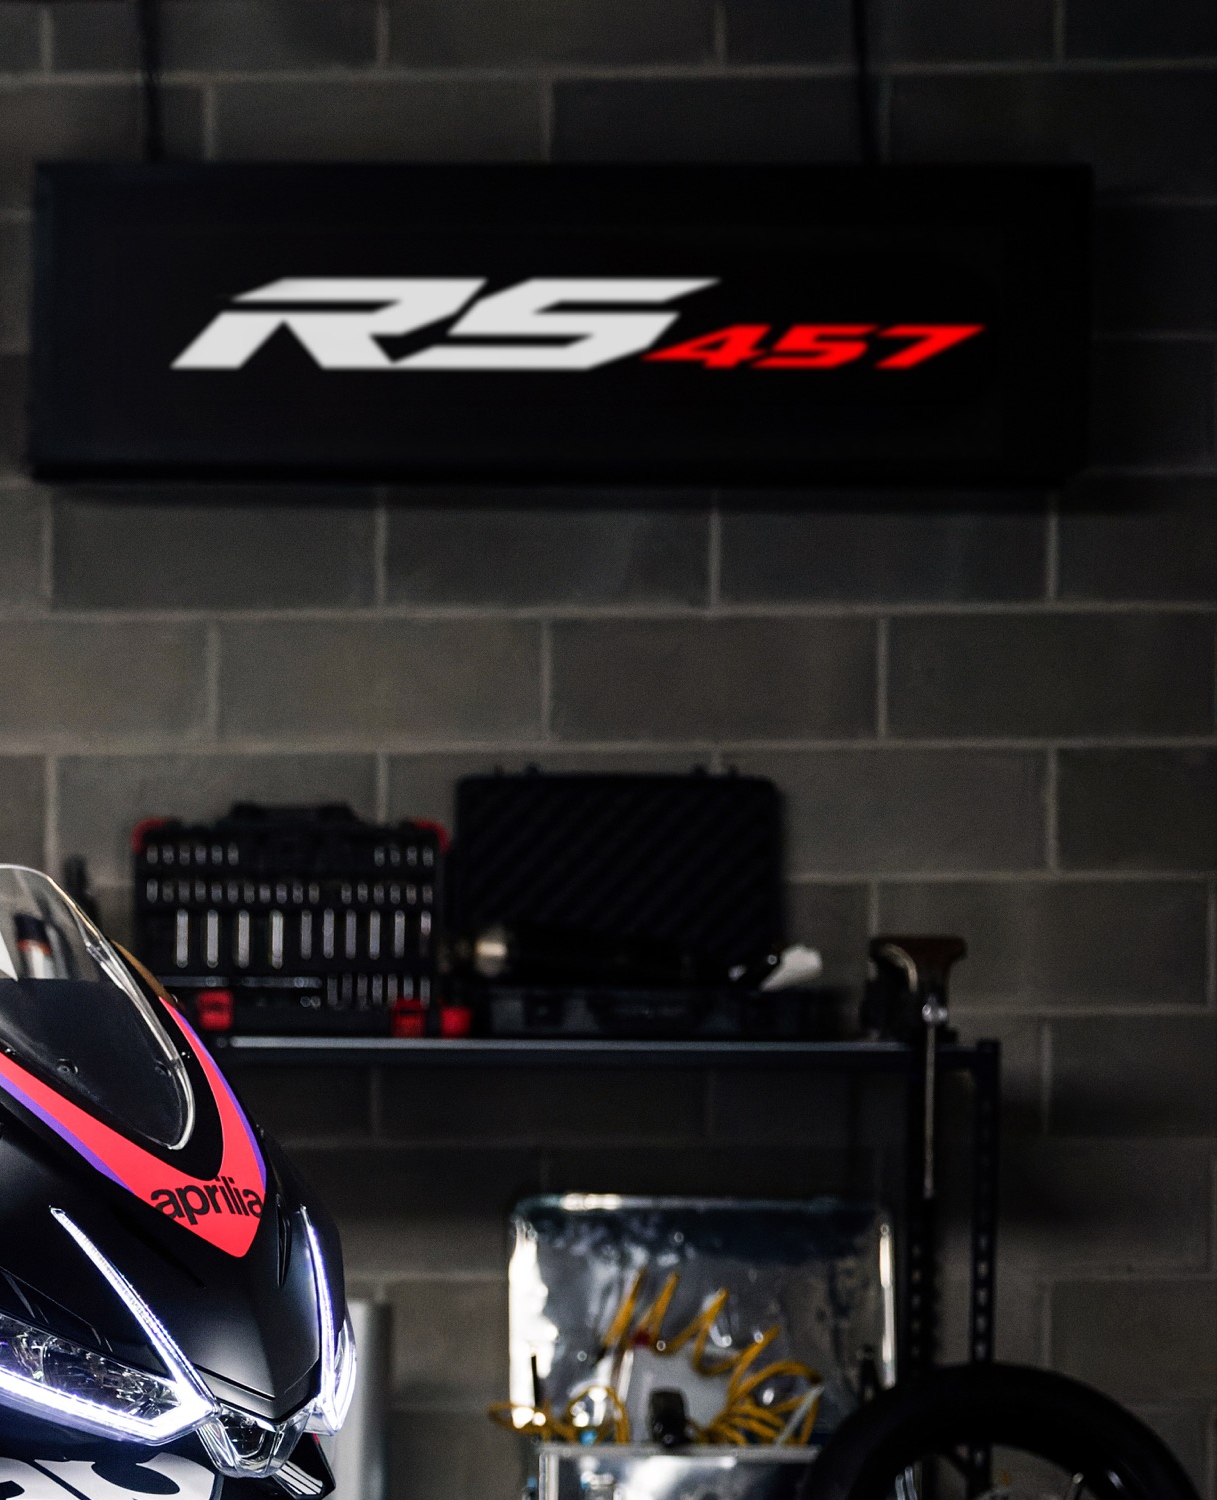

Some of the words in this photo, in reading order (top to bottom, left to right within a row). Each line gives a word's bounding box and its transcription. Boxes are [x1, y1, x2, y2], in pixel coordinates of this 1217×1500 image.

[170, 277, 719, 371] RS
[643, 323, 983, 369] 457
[150, 1175, 265, 1225] aprilia
